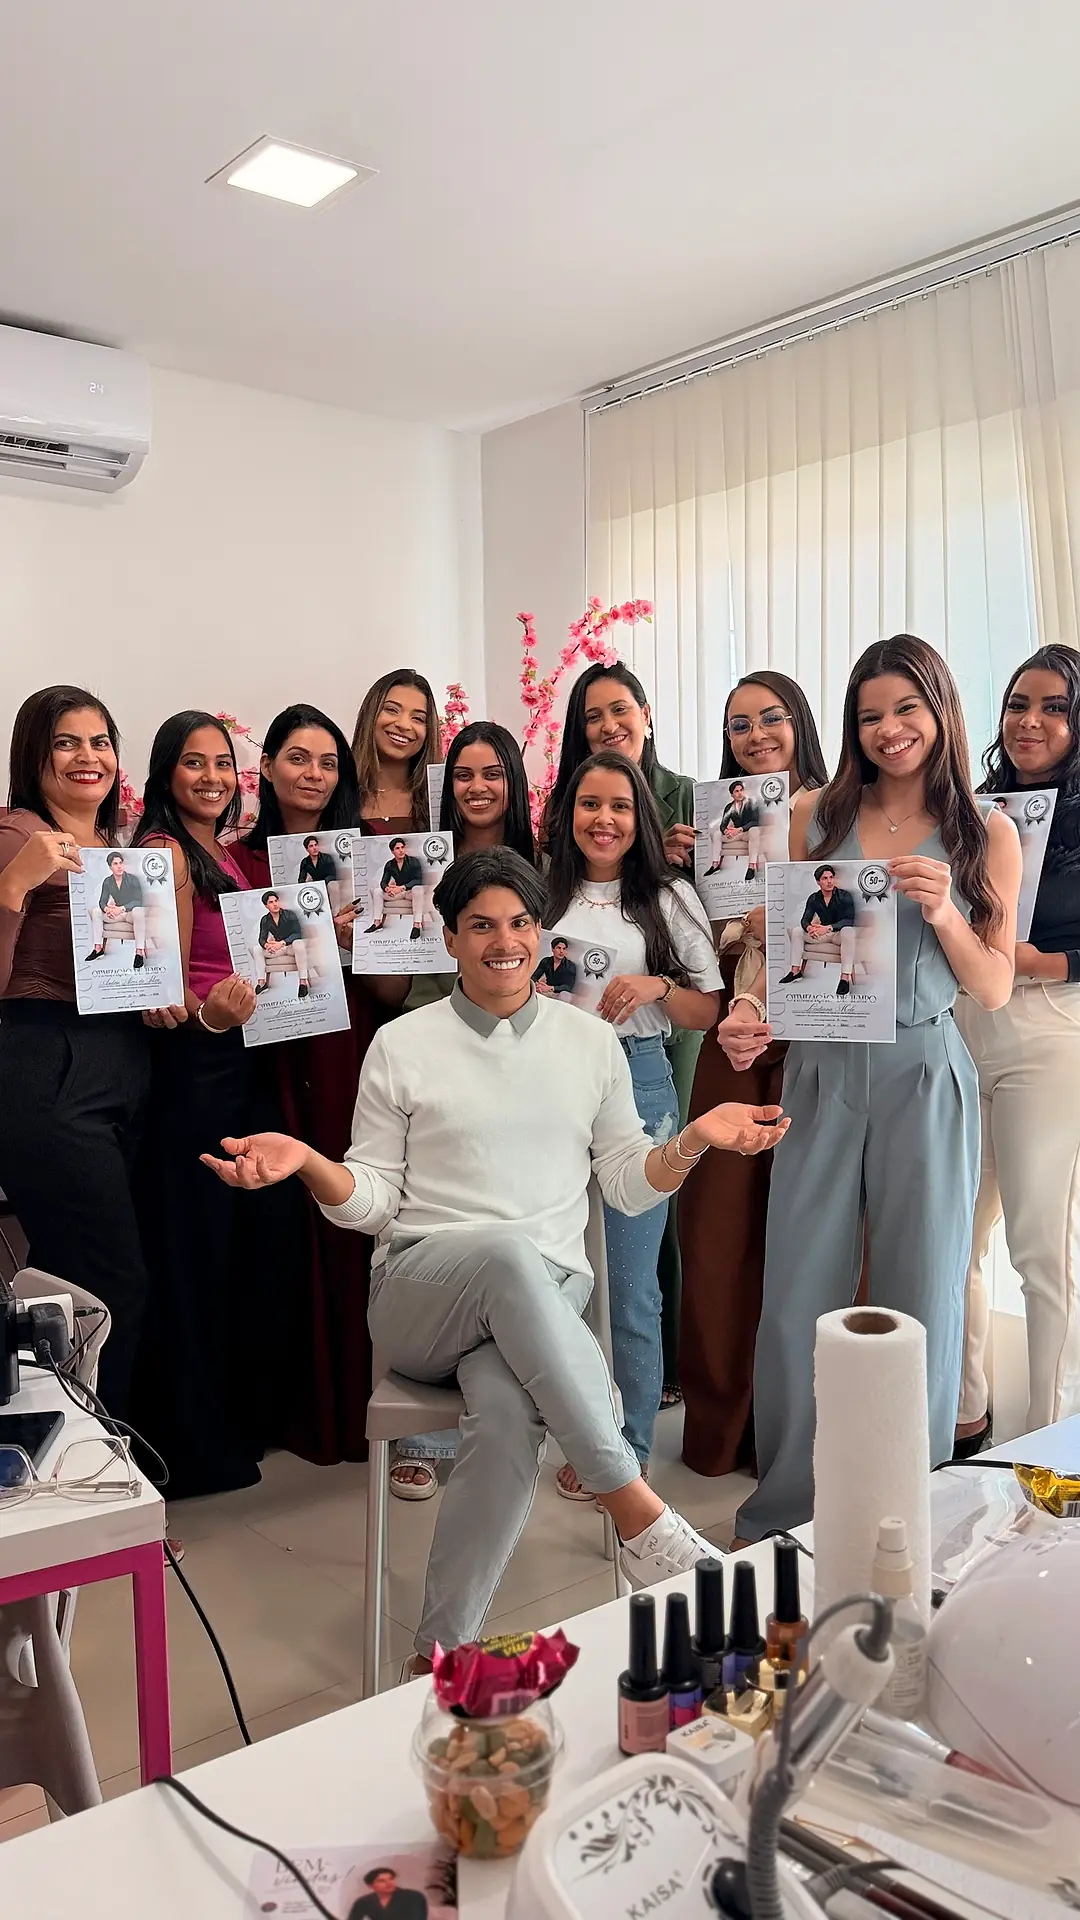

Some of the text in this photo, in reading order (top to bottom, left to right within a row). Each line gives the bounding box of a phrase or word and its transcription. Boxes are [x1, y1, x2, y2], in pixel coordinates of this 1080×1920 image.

[90, 382, 104, 394] 24
[870, 876, 878, 884] 50
[767, 866, 785, 1036] CERTIFICADO
